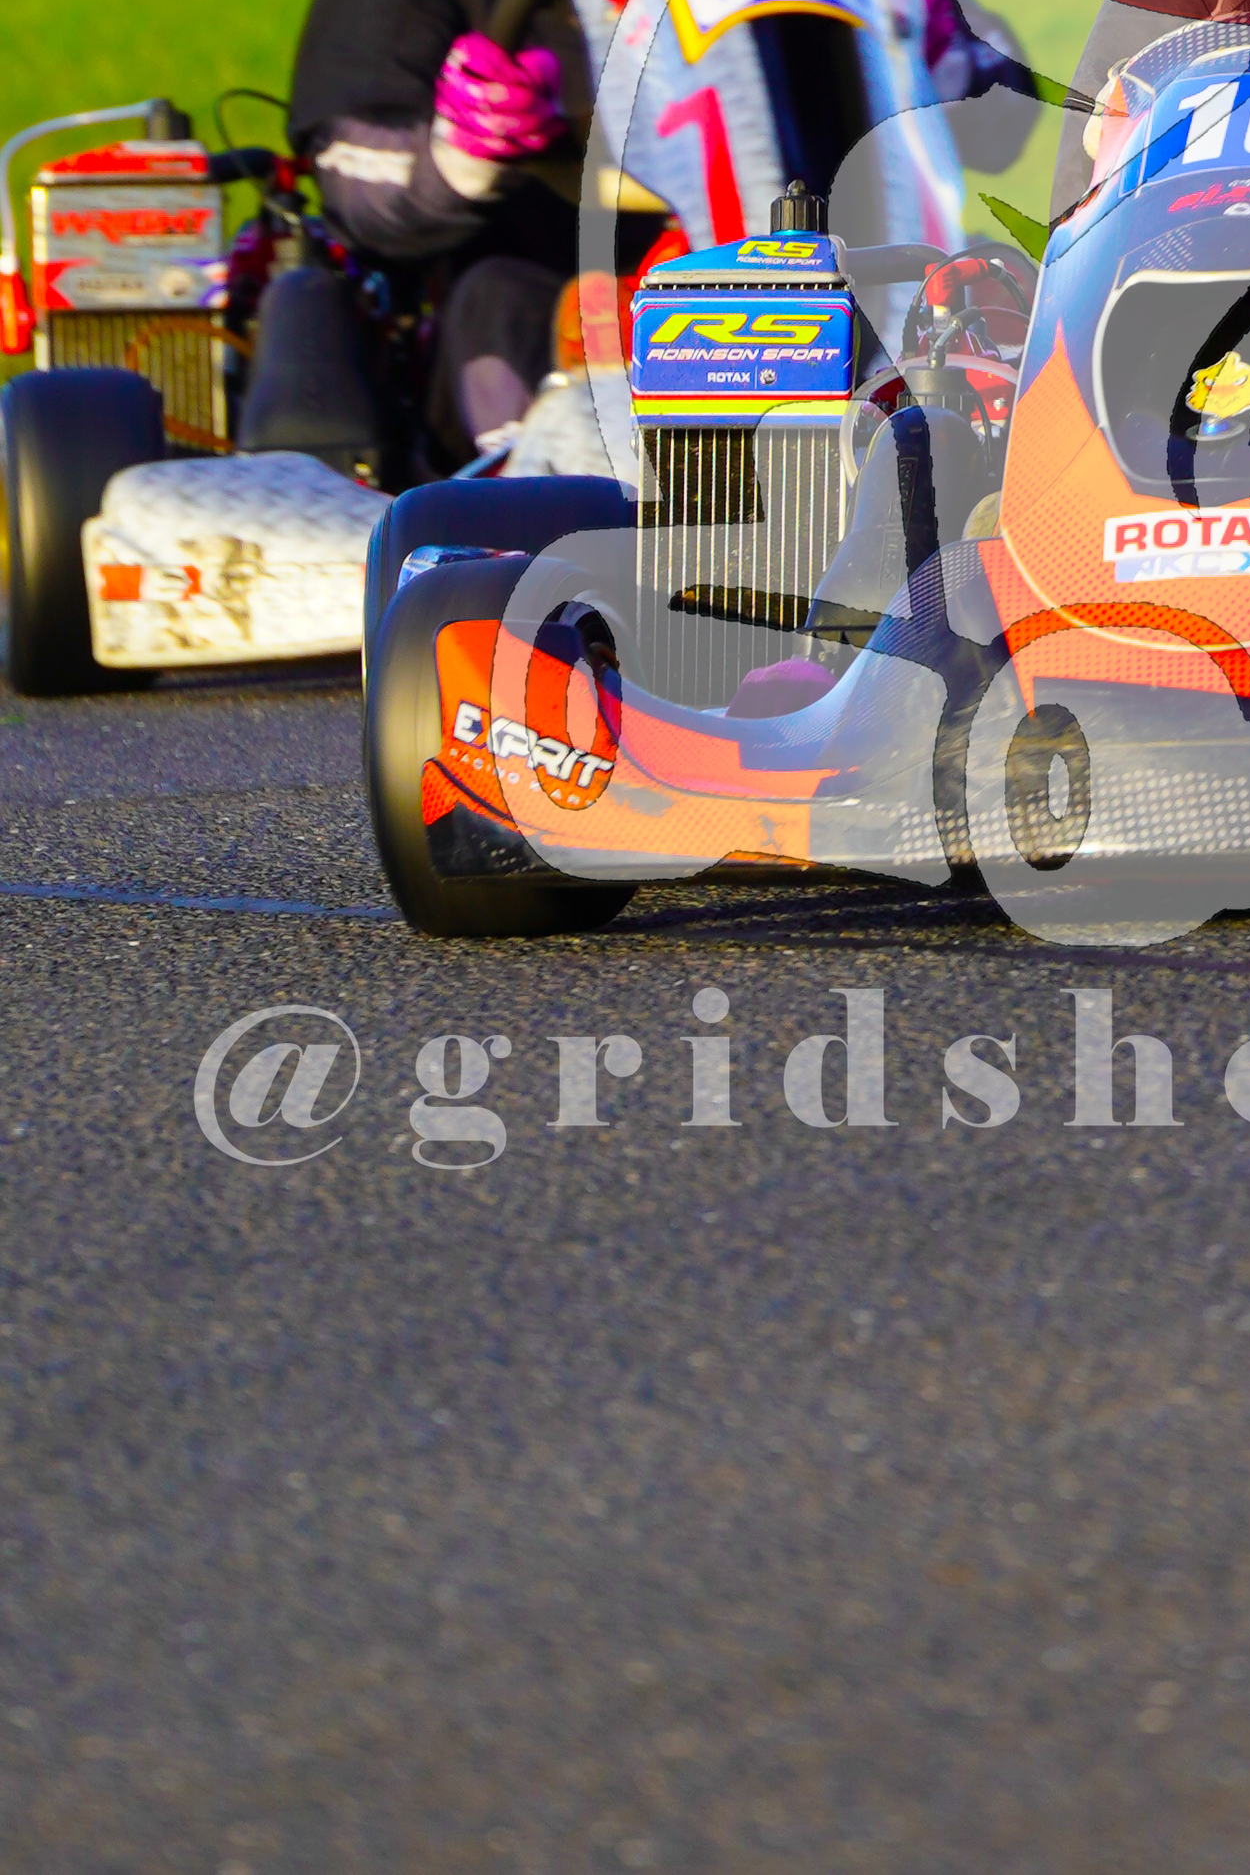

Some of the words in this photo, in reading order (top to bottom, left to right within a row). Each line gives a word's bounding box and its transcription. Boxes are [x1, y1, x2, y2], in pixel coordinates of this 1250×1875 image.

[737, 240, 819, 258] RS
[649, 313, 832, 345] RS
[646, 348, 760, 362] ROBINSON
[760, 348, 841, 361] SPORT
[706, 371, 751, 383] ROTAX
[453, 701, 615, 789] EXPRIT
